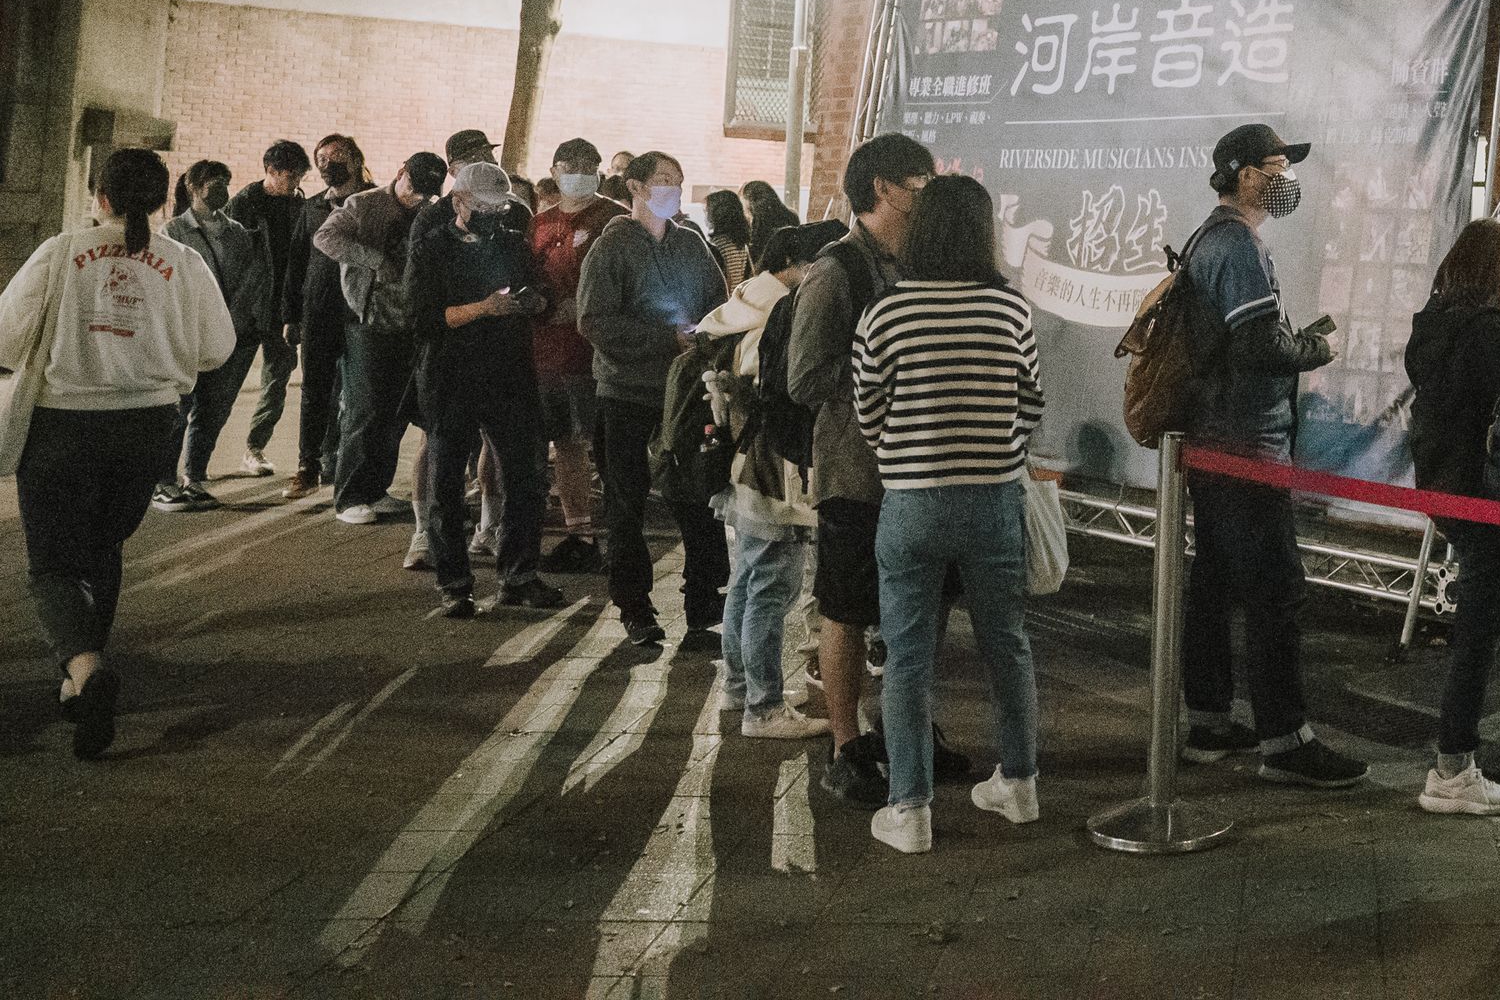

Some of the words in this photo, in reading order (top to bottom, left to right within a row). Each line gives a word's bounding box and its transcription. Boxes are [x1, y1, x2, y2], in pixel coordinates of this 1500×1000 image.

[1000, 149, 1079, 169] RIVERSIDE
[1084, 148, 1174, 169] MUSICIANS
[1178, 147, 1216, 168] INST
[1066, 184, 1168, 273] 招生
